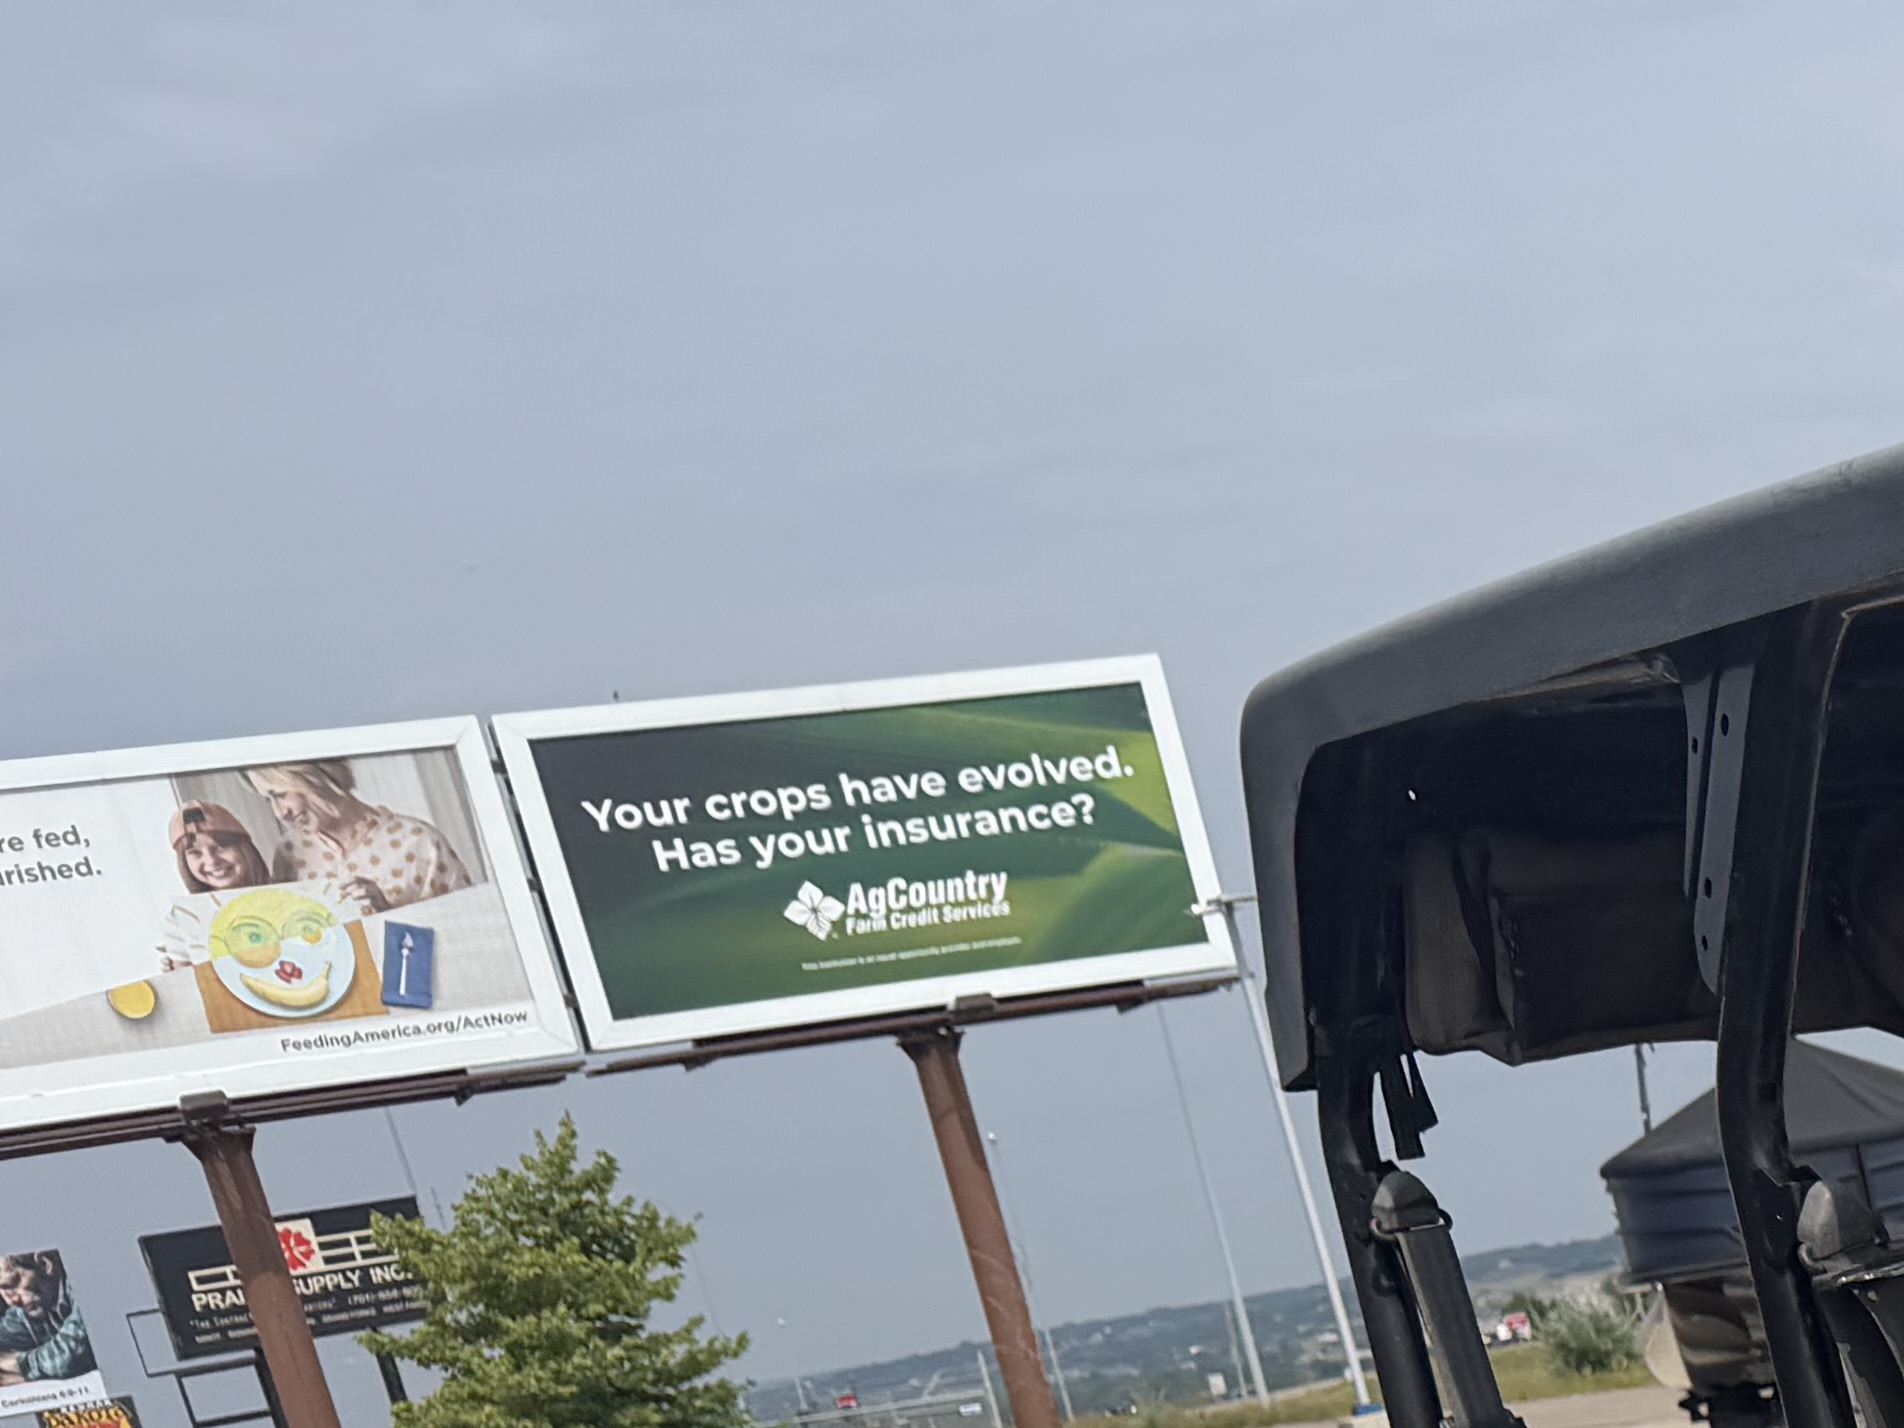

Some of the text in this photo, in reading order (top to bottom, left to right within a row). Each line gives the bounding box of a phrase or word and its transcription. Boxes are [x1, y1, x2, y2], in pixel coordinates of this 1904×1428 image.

[581, 744, 1134, 832] Your crops have evolved.
[32, 824, 90, 849] fed,
[652, 793, 1095, 872] Has your insurance?
[847, 869, 1008, 918] AgCountry
[845, 901, 1011, 936] Farm Credit Services
[280, 1010, 528, 1052] FeedingAmerica.org/ActNow
[191, 1288, 246, 1313] PRAI
